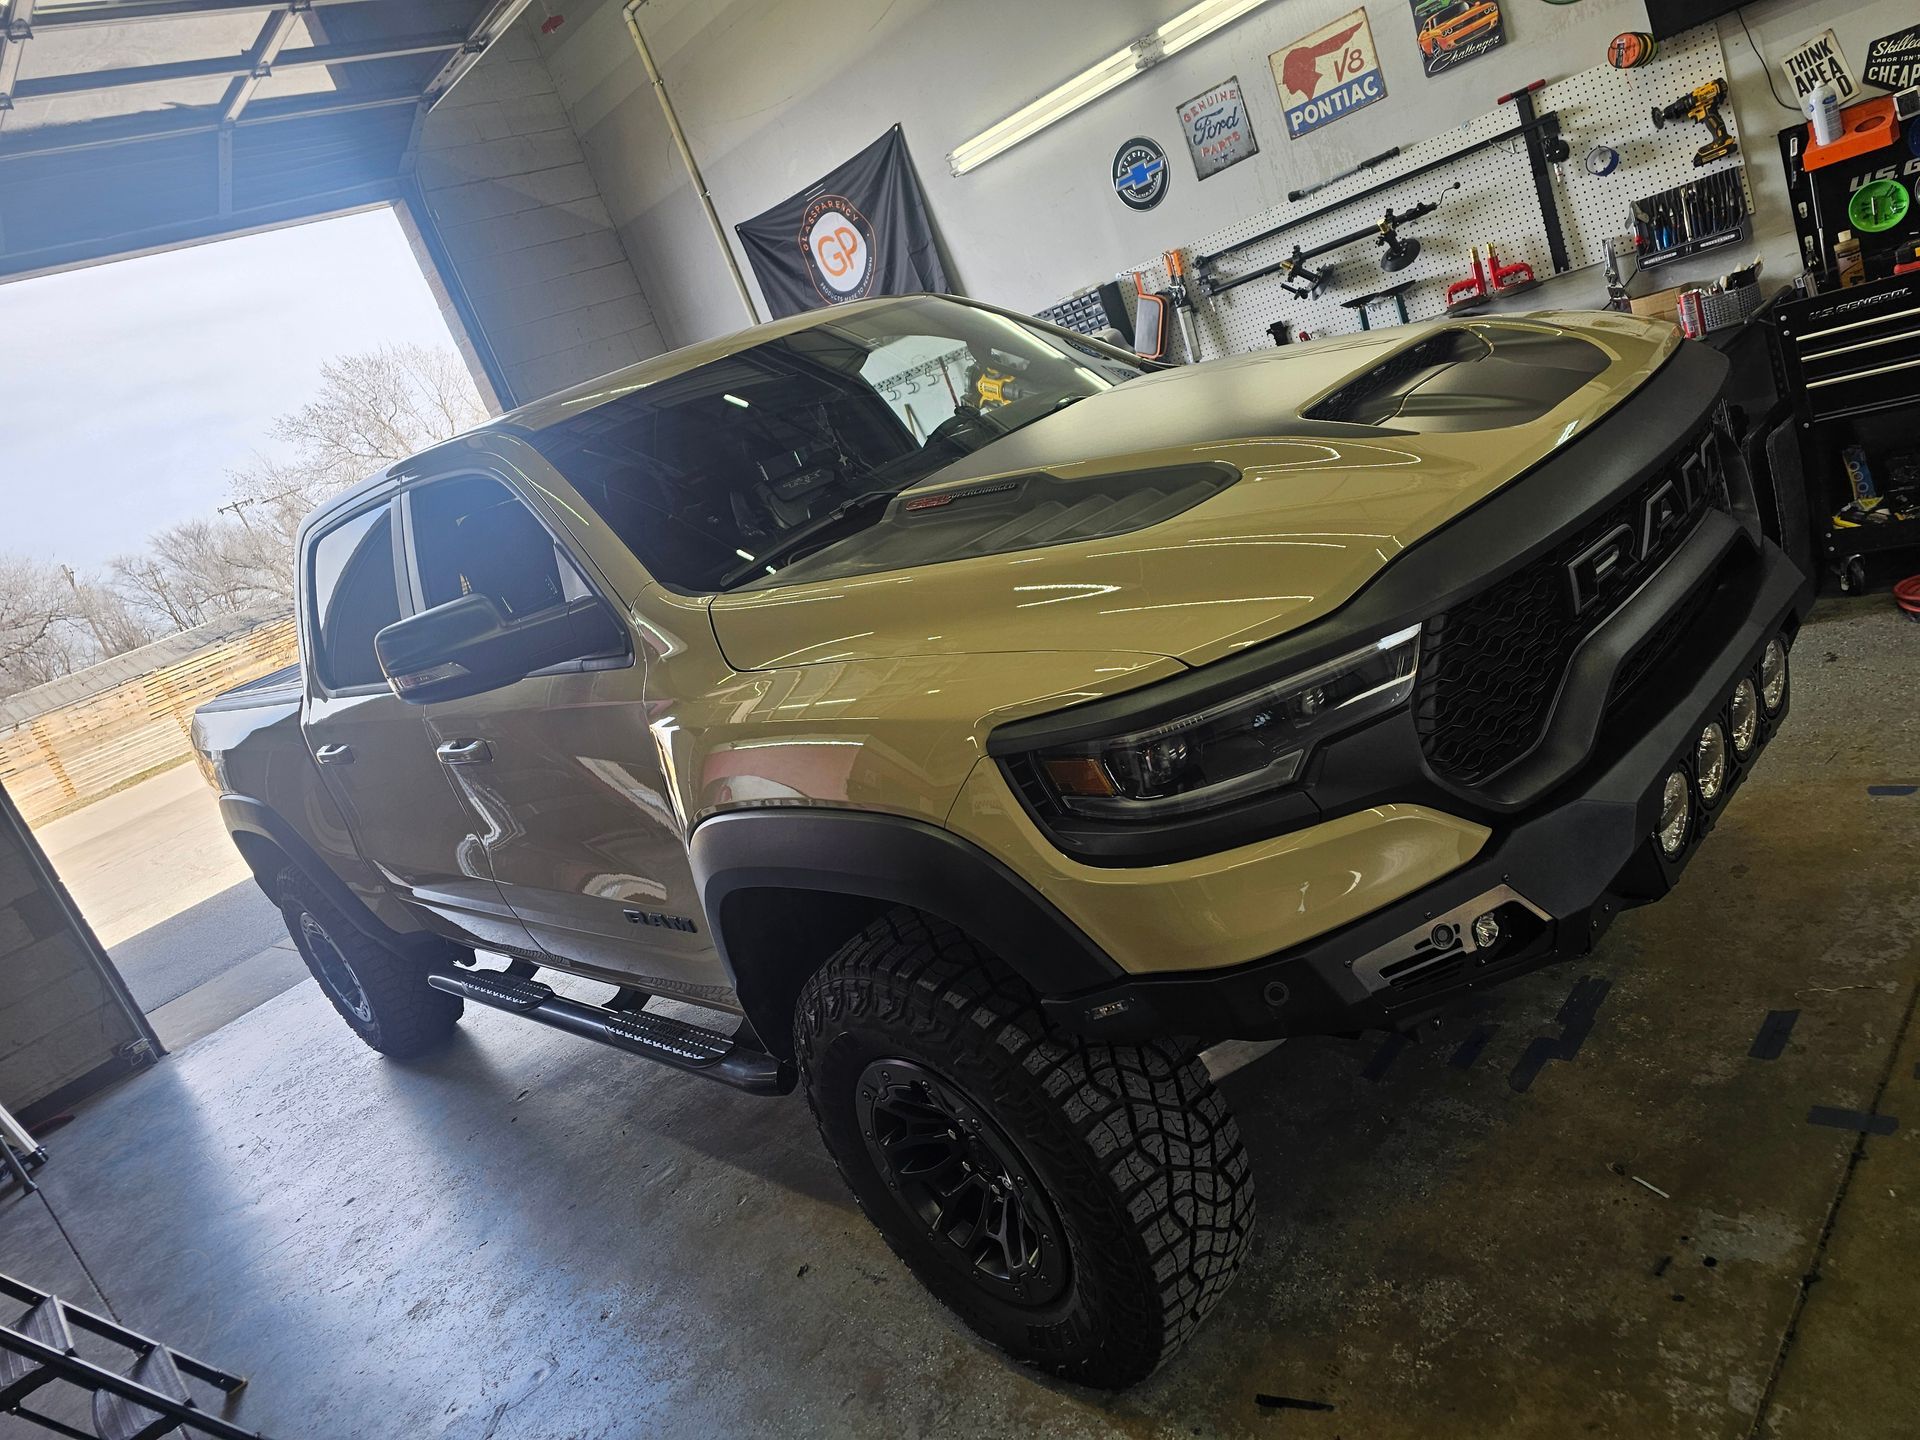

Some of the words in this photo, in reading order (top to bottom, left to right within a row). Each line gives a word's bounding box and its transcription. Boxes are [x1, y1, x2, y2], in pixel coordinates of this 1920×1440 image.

[1333, 47, 1365, 83] V8
[1428, 35, 1500, 73] Challenger
[1784, 37, 1834, 76] THINK
[1868, 63, 1920, 88] CHEAP
[1183, 89, 1237, 122] GENUINE
[1290, 76, 1379, 131] PONTIAC
[1193, 106, 1240, 146] Ford
[1201, 131, 1241, 157] PARTS
[801, 200, 859, 252] GLASSPARENCY
[817, 226, 858, 277] GP
[820, 282, 844, 302] PRODUCTS
[1567, 431, 1717, 616] RAM
